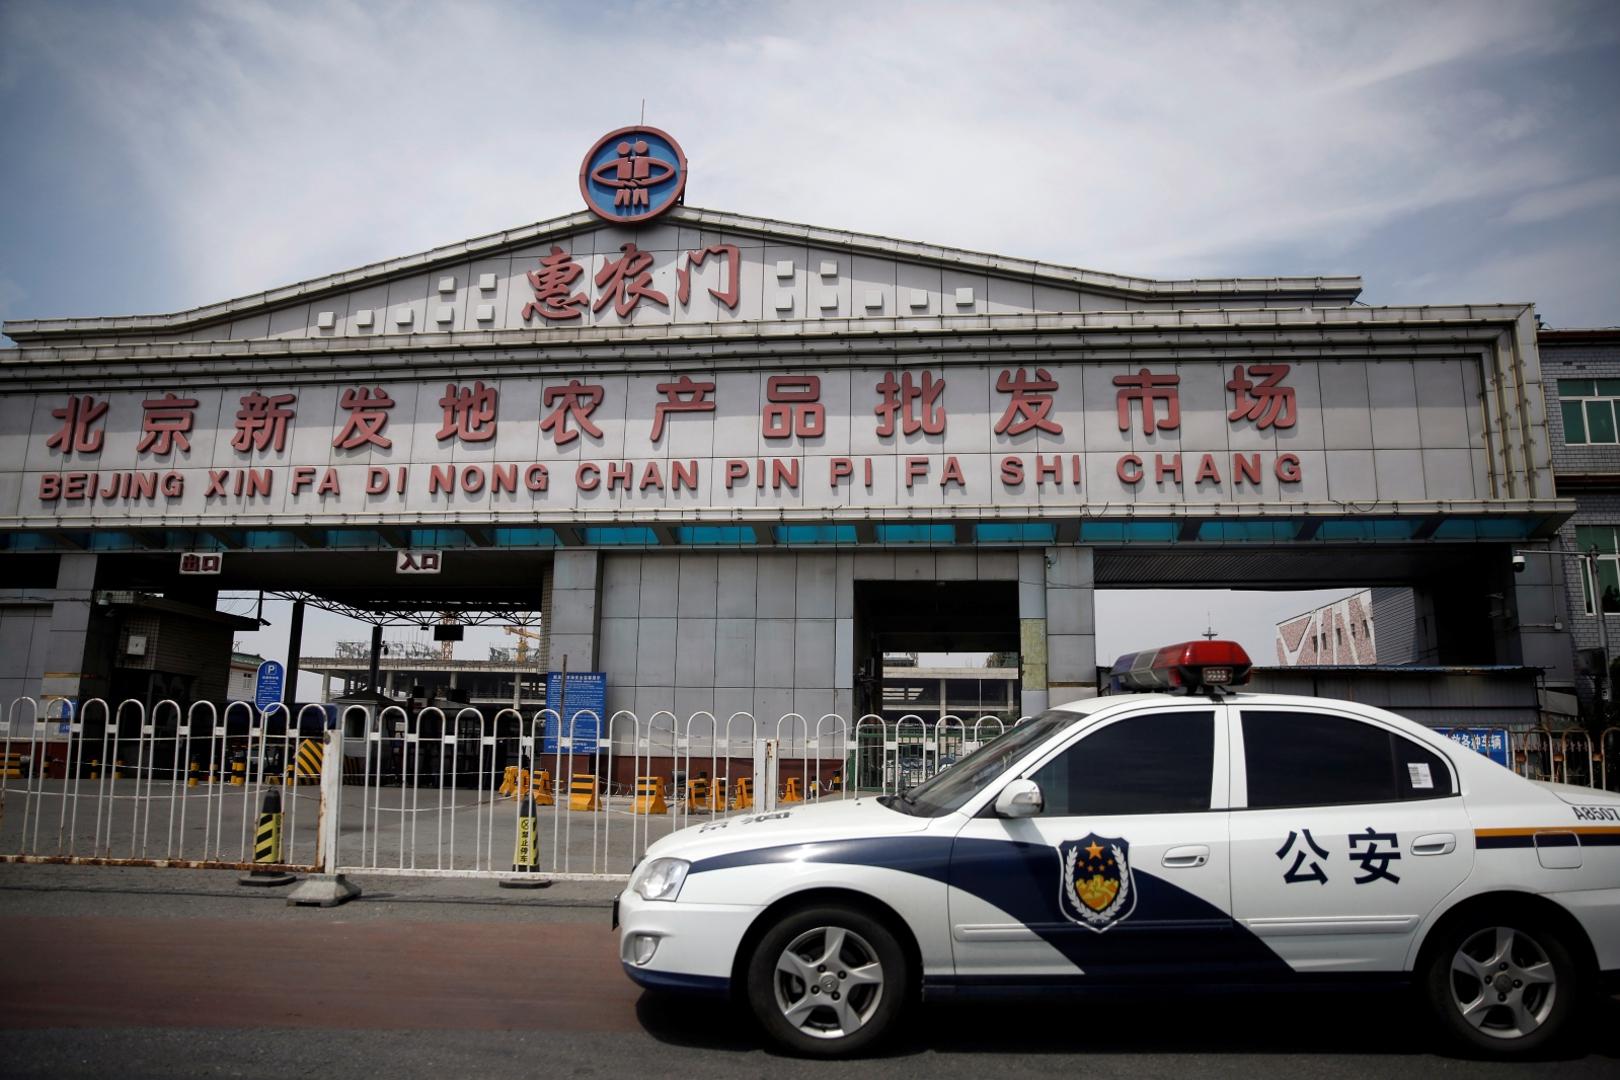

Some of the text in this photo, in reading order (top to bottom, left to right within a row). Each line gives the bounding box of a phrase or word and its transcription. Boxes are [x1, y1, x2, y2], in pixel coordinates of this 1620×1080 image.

[521, 243, 741, 320] 惠农门
[47, 363, 1297, 454] 北京新发地农产品批发市场
[39, 452, 1302, 500] BEIJING XIN FA DI NONG CHAN PIN PI FA SHI CHANG
[181, 553, 220, 572] 出口
[400, 552, 439, 570] 入口
[1275, 826, 1402, 886] 公安
